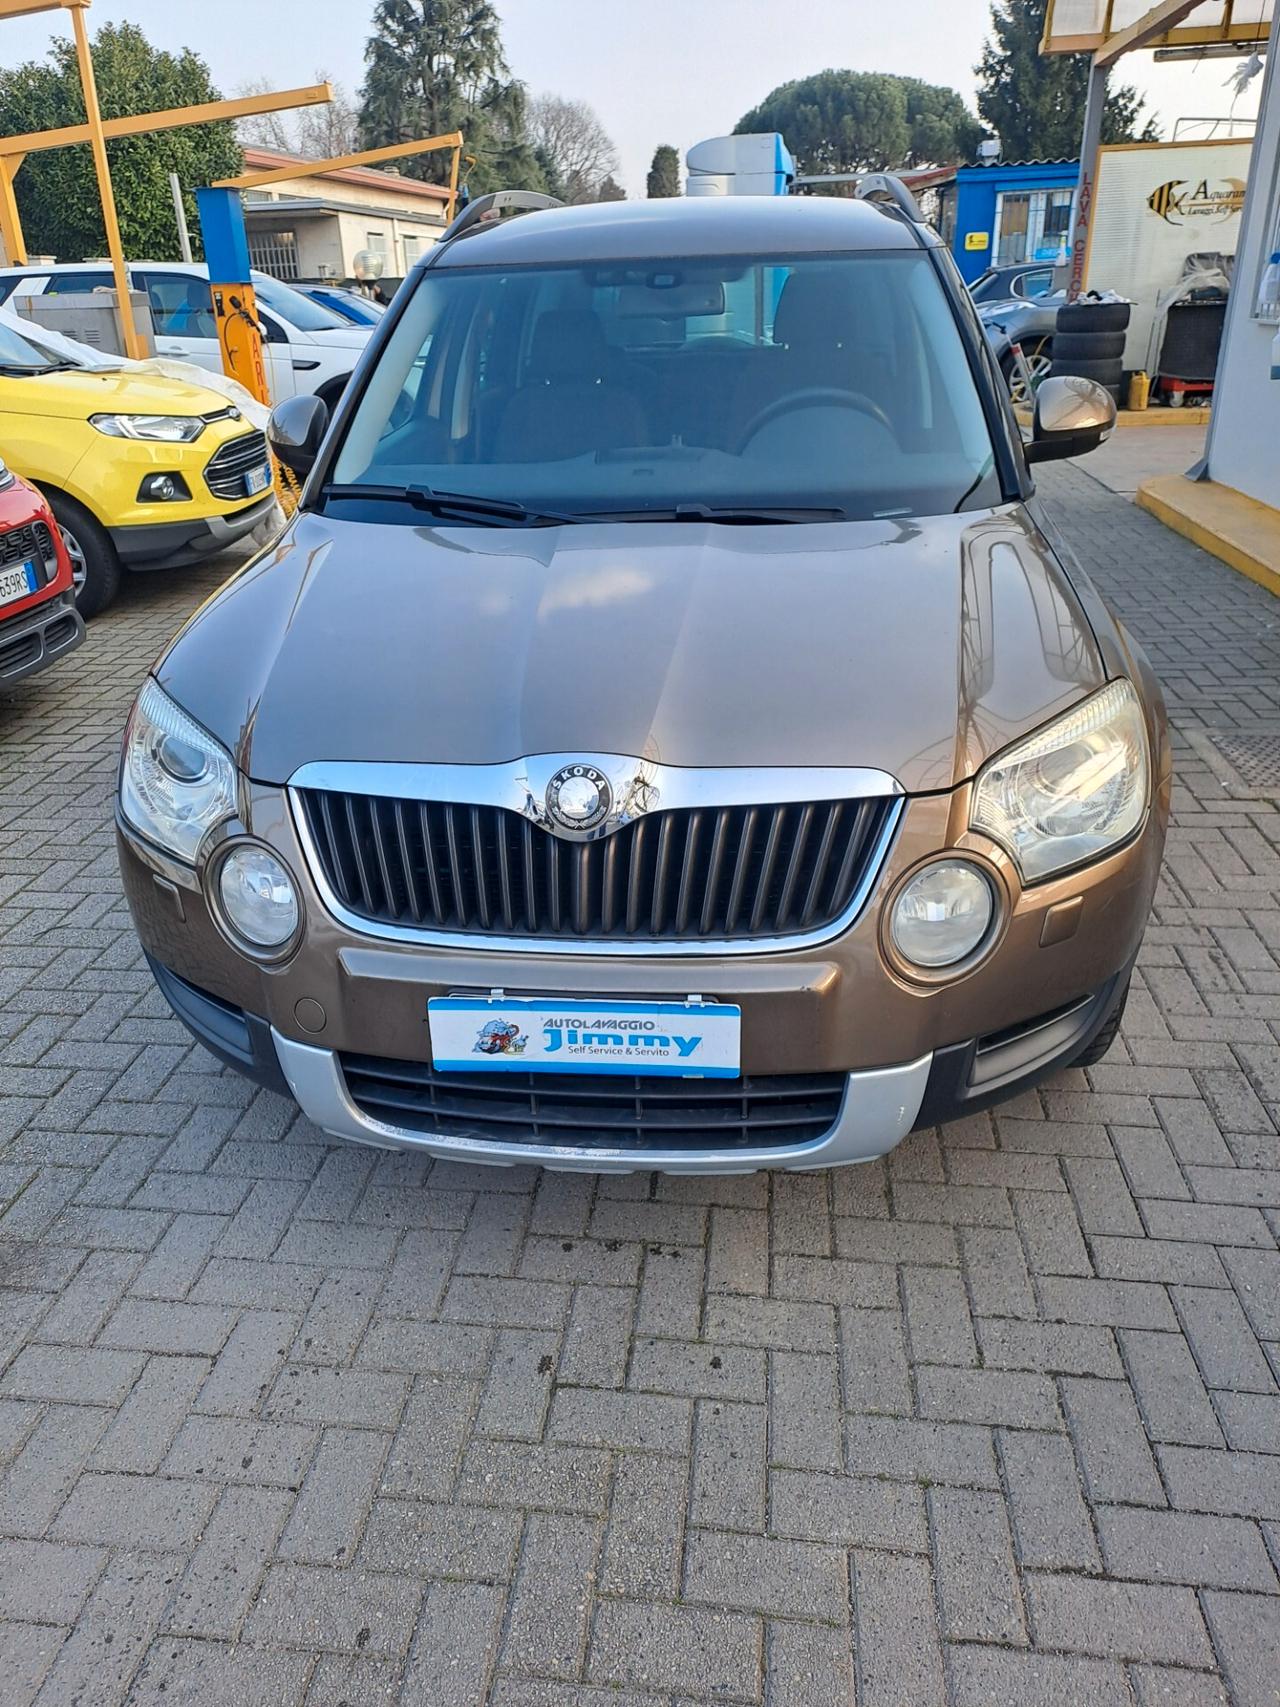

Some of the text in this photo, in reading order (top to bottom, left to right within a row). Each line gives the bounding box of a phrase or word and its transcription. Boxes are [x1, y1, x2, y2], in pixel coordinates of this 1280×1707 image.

[1077, 172, 1091, 227] LAVA
[543, 1018, 655, 1031] AUTOLAVAGGIO
[568, 1045, 670, 1057] Self Service & Servito
